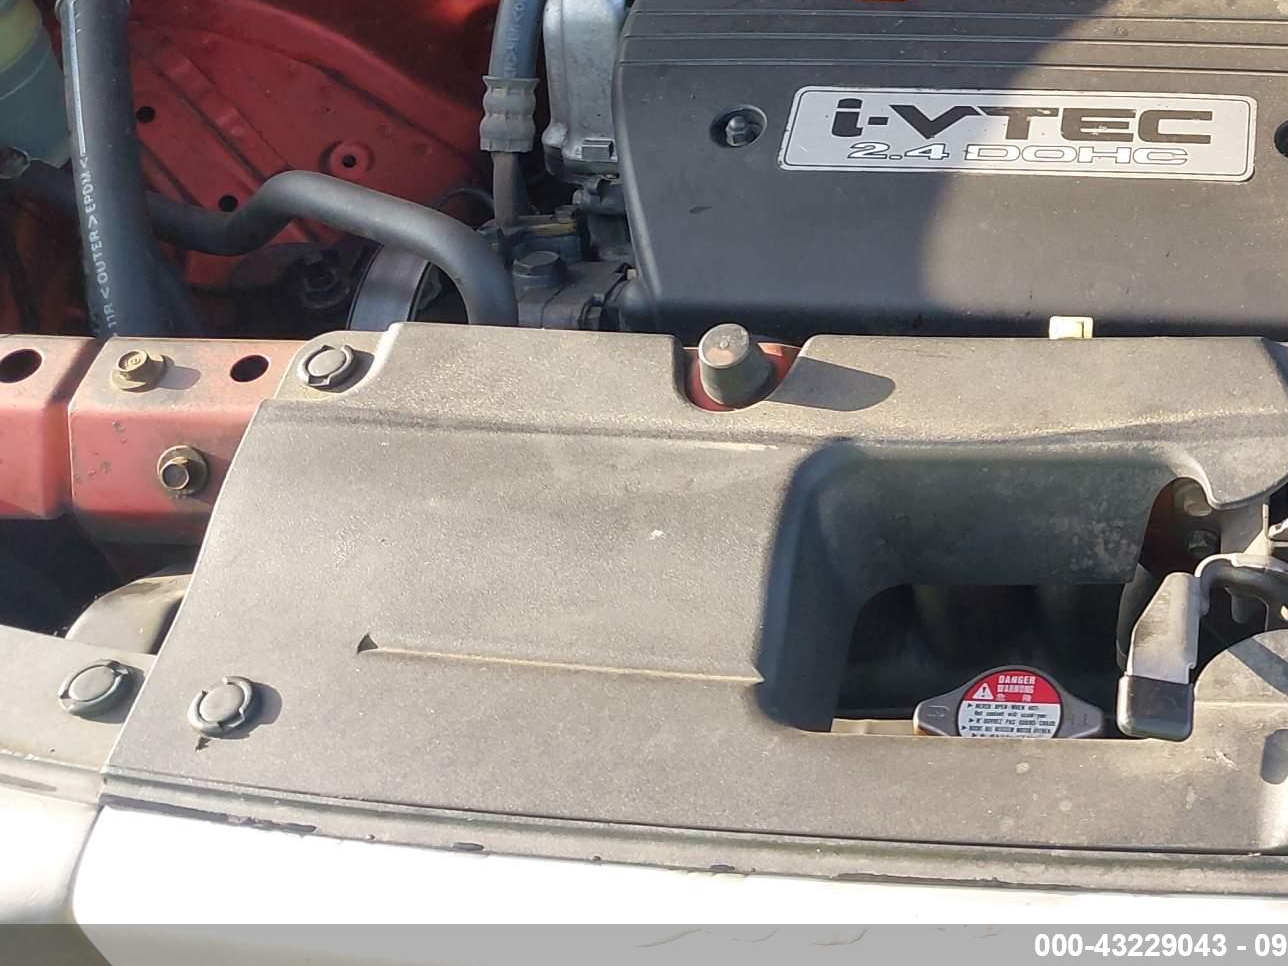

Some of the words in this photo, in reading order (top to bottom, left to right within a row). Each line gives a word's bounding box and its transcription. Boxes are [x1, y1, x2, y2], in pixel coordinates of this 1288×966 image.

[831, 98, 1214, 145] i-VTEC
[847, 141, 950, 161] 2.4
[963, 143, 1189, 165] DOHC
[998, 674, 1037, 685] DANGER
